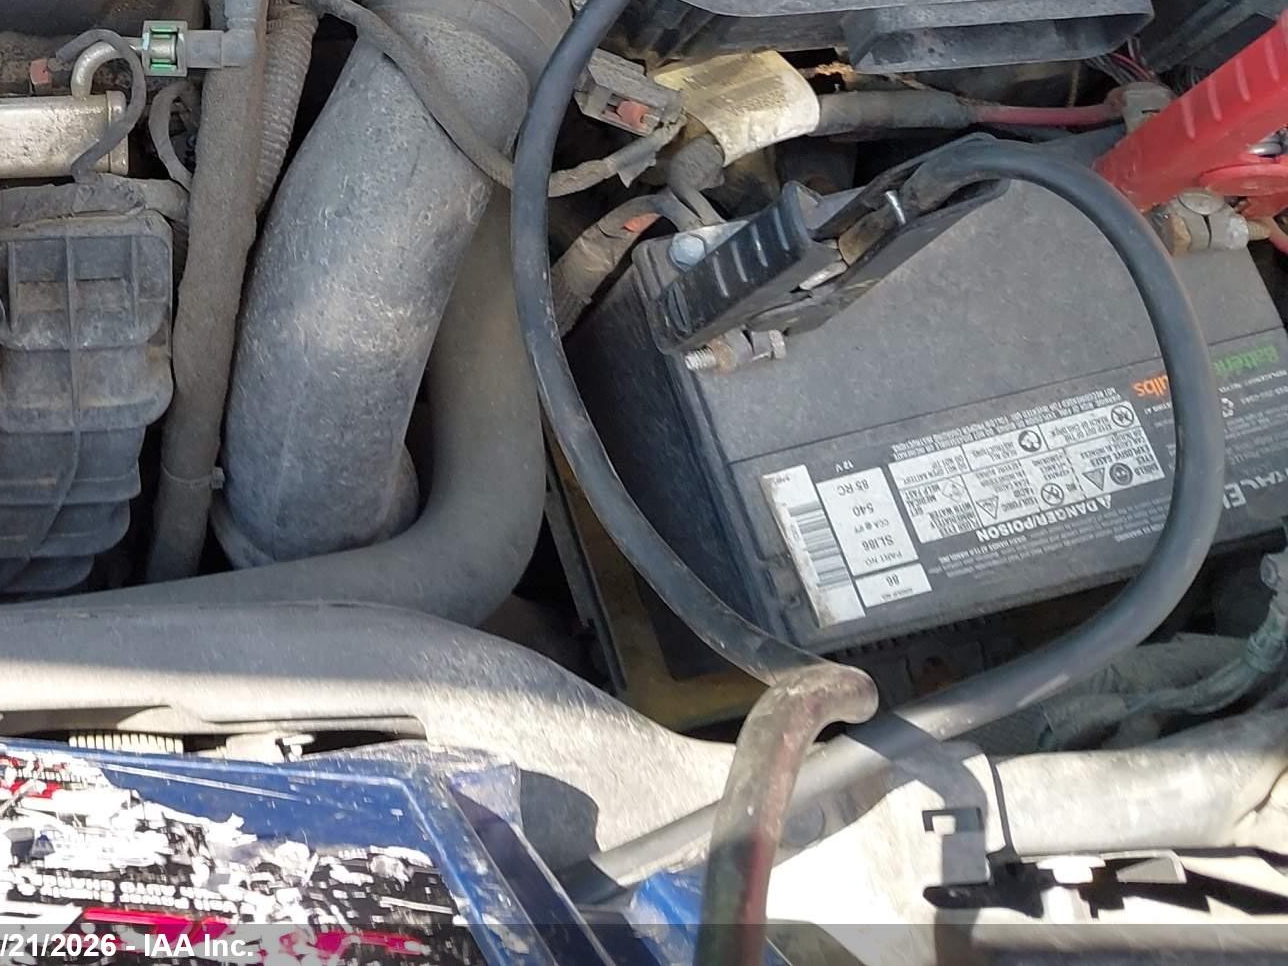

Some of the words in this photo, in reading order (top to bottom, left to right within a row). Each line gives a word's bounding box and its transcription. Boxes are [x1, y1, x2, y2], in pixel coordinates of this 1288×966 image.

[1133, 375, 1169, 397] ulbs
[1112, 444, 1150, 461] EXPLOSIVE
[833, 462, 843, 472] V
[840, 458, 854, 470] 12
[835, 482, 854, 496] RC
[854, 478, 870, 491] 85
[905, 494, 937, 509] MEDICAL
[851, 501, 875, 517] 540
[872, 517, 889, 528] CCA
[928, 509, 976, 529] IMMEDIATELY
[974, 498, 1099, 543] DANGER/POISON
[860, 533, 895, 552] SLI86
[878, 549, 903, 563] PART
[884, 573, 900, 586] 86
